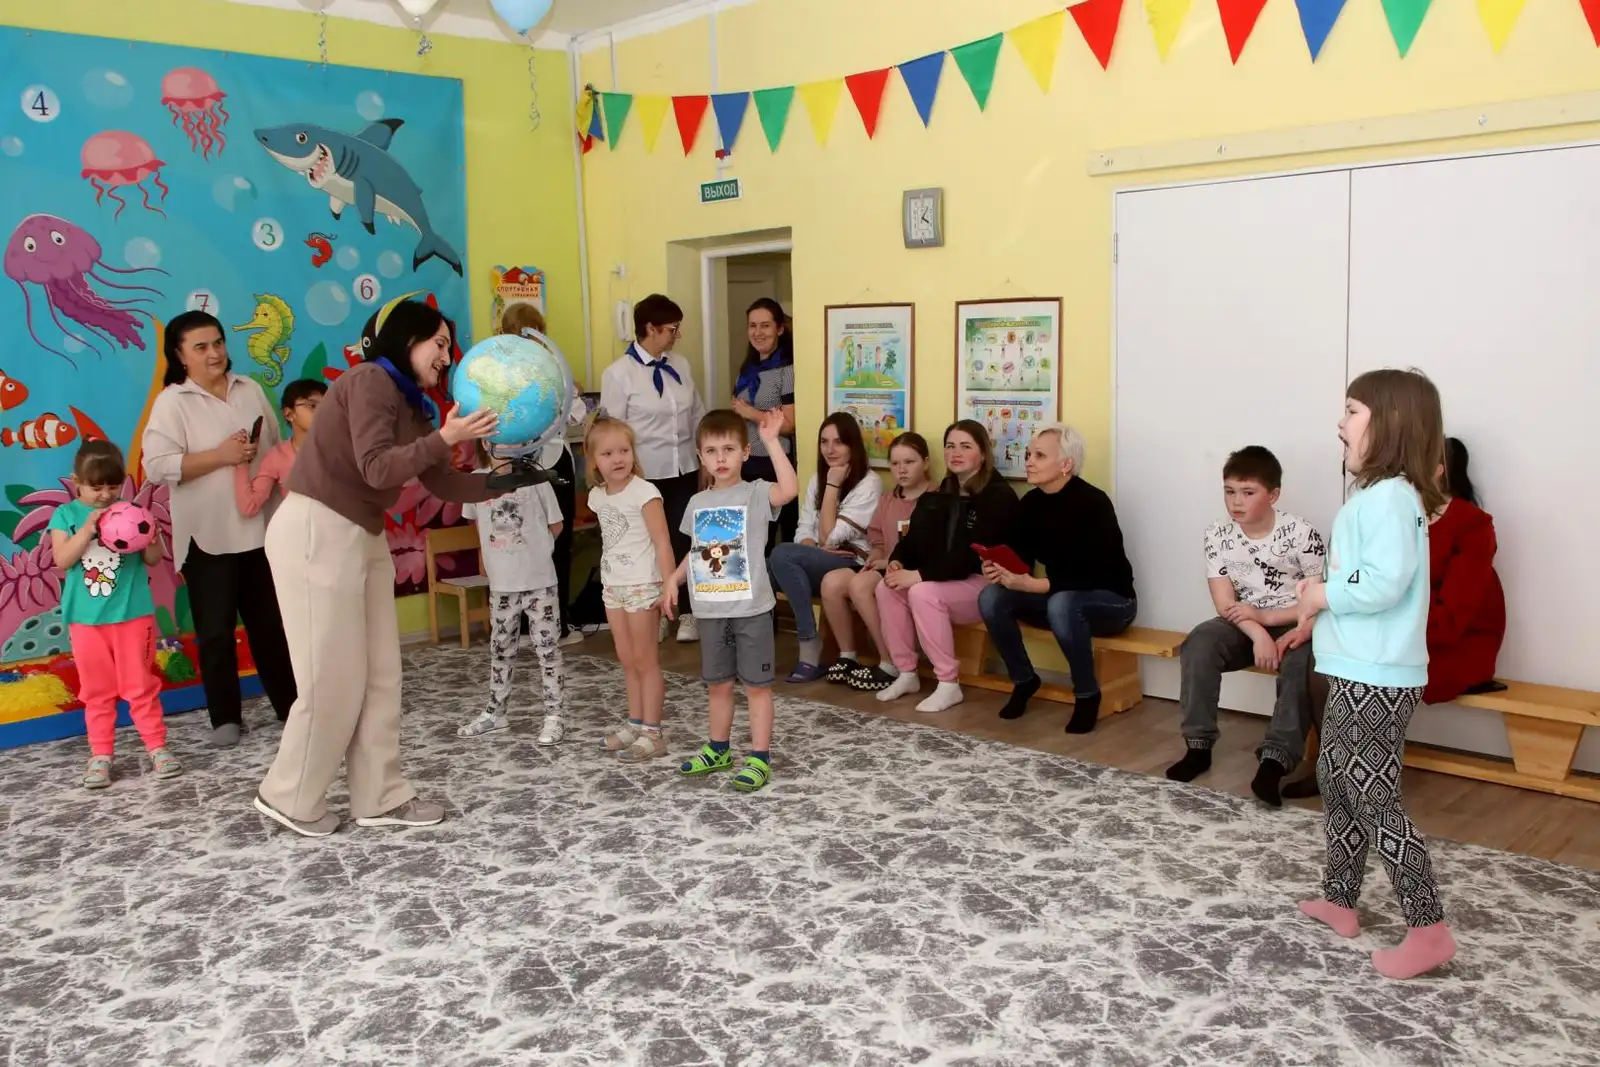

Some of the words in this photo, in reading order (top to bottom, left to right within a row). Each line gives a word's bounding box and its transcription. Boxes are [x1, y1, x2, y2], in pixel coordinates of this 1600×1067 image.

[31, 90, 49, 116] 4
[703, 182, 737, 199] ВЫХОД
[260, 223, 276, 246] 3
[360, 278, 373, 300] 6
[194, 294, 209, 313] 7
